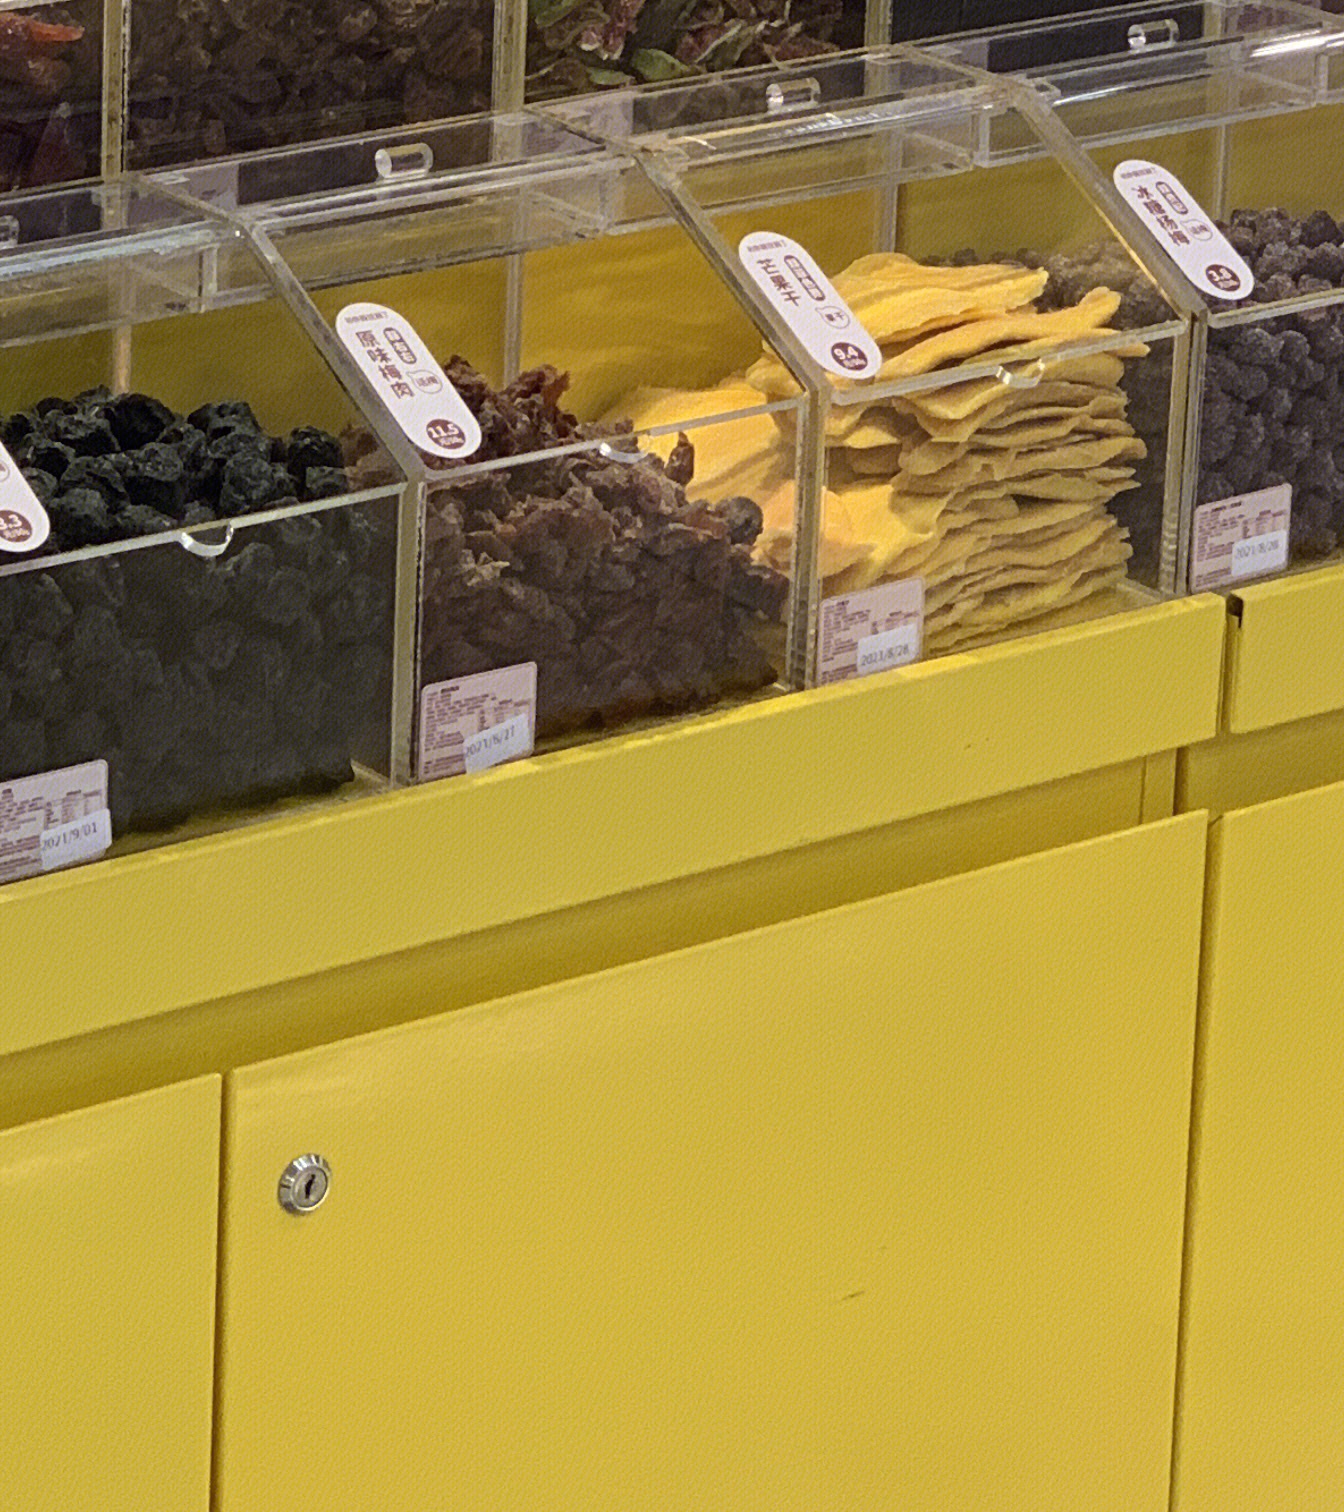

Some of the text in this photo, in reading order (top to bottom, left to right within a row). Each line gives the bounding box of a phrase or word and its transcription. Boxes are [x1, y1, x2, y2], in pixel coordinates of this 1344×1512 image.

[1132, 186, 1190, 246] 冰糖杨梅
[756, 258, 802, 306] 芒果干
[355, 330, 416, 399] 原味梅肉
[834, 347, 860, 360] 9.4
[428, 425, 459, 439] 11.5
[42, 822, 98, 852] 2021/9/01
